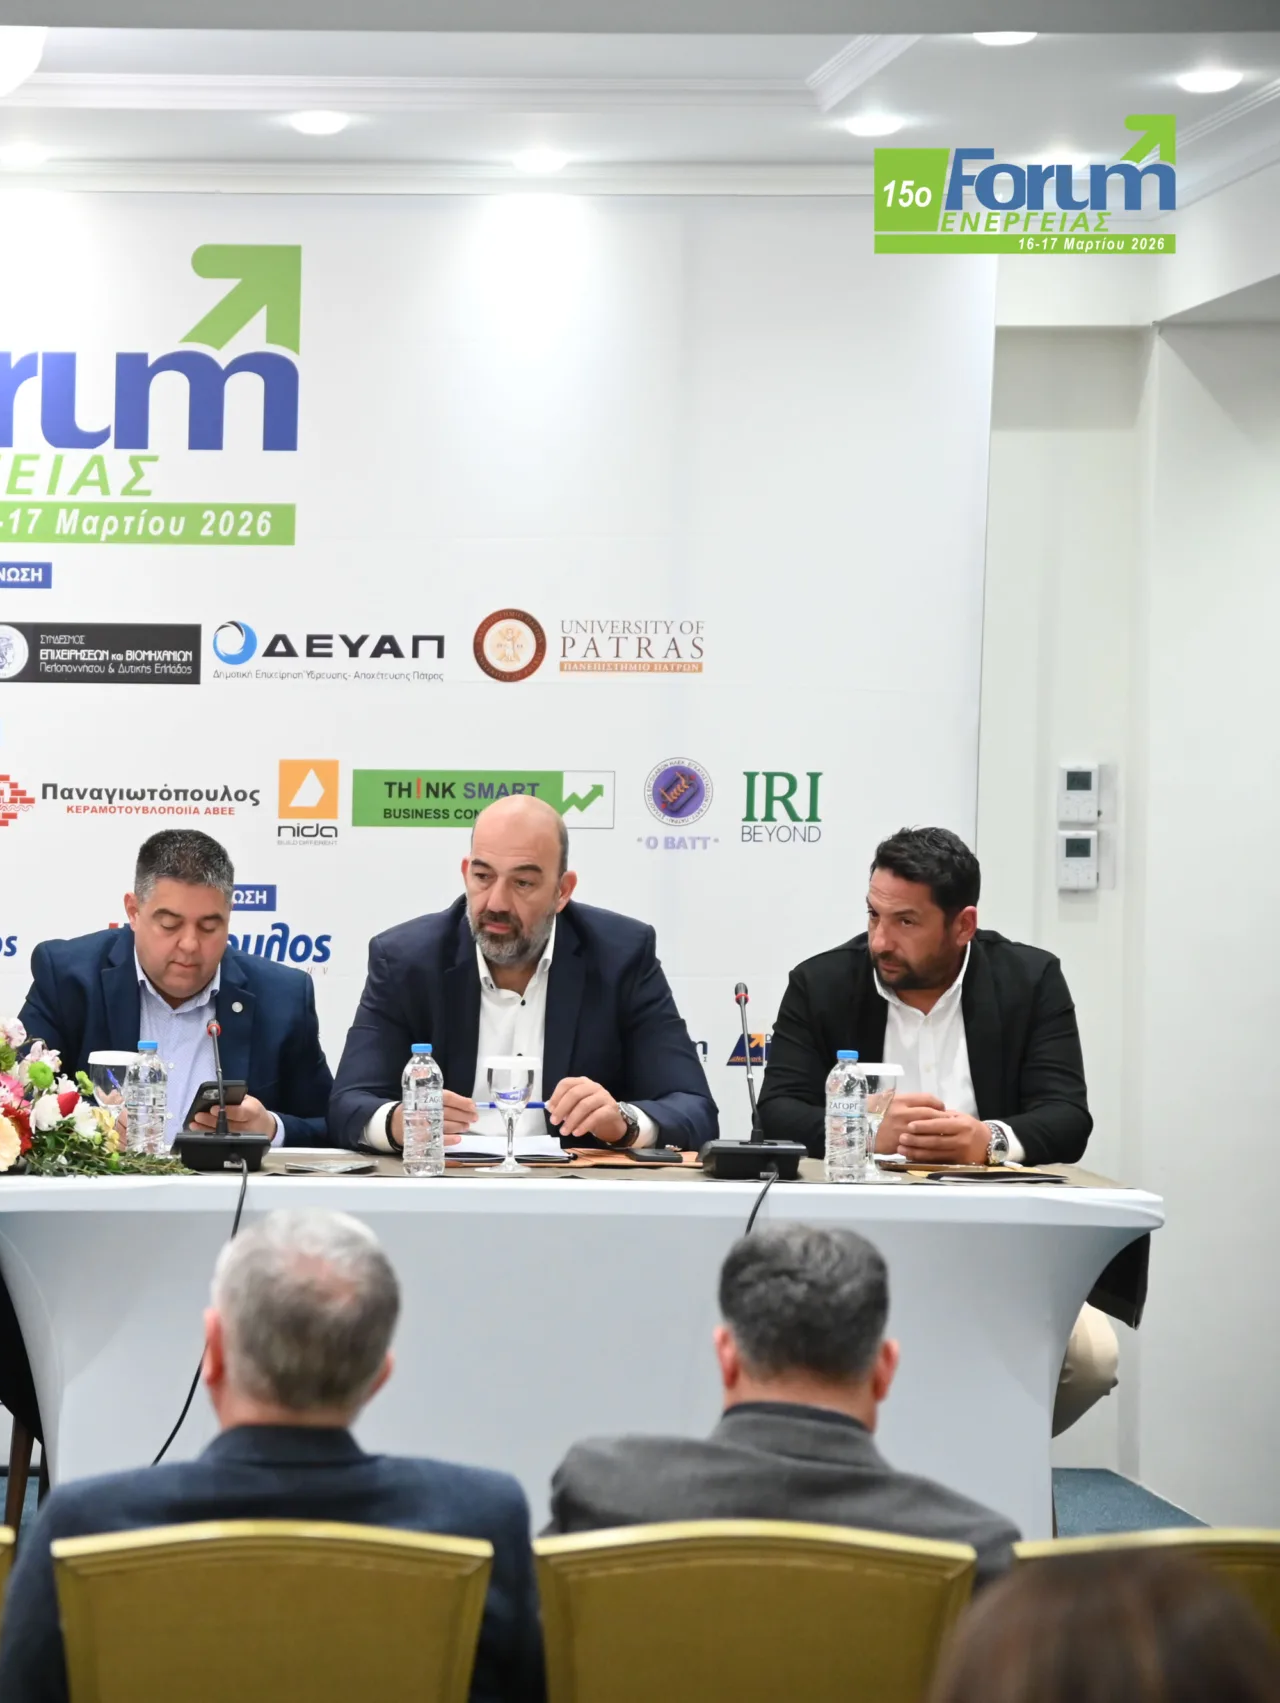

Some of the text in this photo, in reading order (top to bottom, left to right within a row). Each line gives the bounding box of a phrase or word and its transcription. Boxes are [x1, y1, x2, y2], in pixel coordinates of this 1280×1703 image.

[55, 506, 186, 542] Μαρτίου
[200, 510, 273, 538] 2026
[560, 620, 705, 635] UNIVERSITY OF
[40, 634, 86, 645] ΣΥΝΔΕΣΜΟΣ
[261, 633, 445, 659] ΔΕΥΑΠ
[40, 649, 193, 662] ΕΠΙΧΕΙΡΗΣΕΩΝ και ΒΙΟΜΗΧΑΝΙΩΝ
[560, 636, 704, 660] PATRAS
[108, 662, 115, 674] &
[118, 663, 152, 674] Δυτικής
[563, 663, 699, 672] ΠΑΝΕΠΙΣΤΗΜΙΟ ΠΑΤΡΩΝ
[213, 669, 253, 680] Δημοτική
[255, 669, 303, 681] Επιχείρηση
[353, 670, 411, 682] Αποχέτευσης
[412, 670, 444, 682] Πάτρας
[41, 782, 261, 807] Παναγιωτόπουλος
[384, 777, 540, 800] TH!NK SMART
[741, 771, 823, 822] IRI
[204, 806, 236, 816] ΑΒΕΕ
[383, 808, 450, 820] BUSINESS
[277, 822, 338, 838] nida
[741, 825, 822, 843] BEYOND
